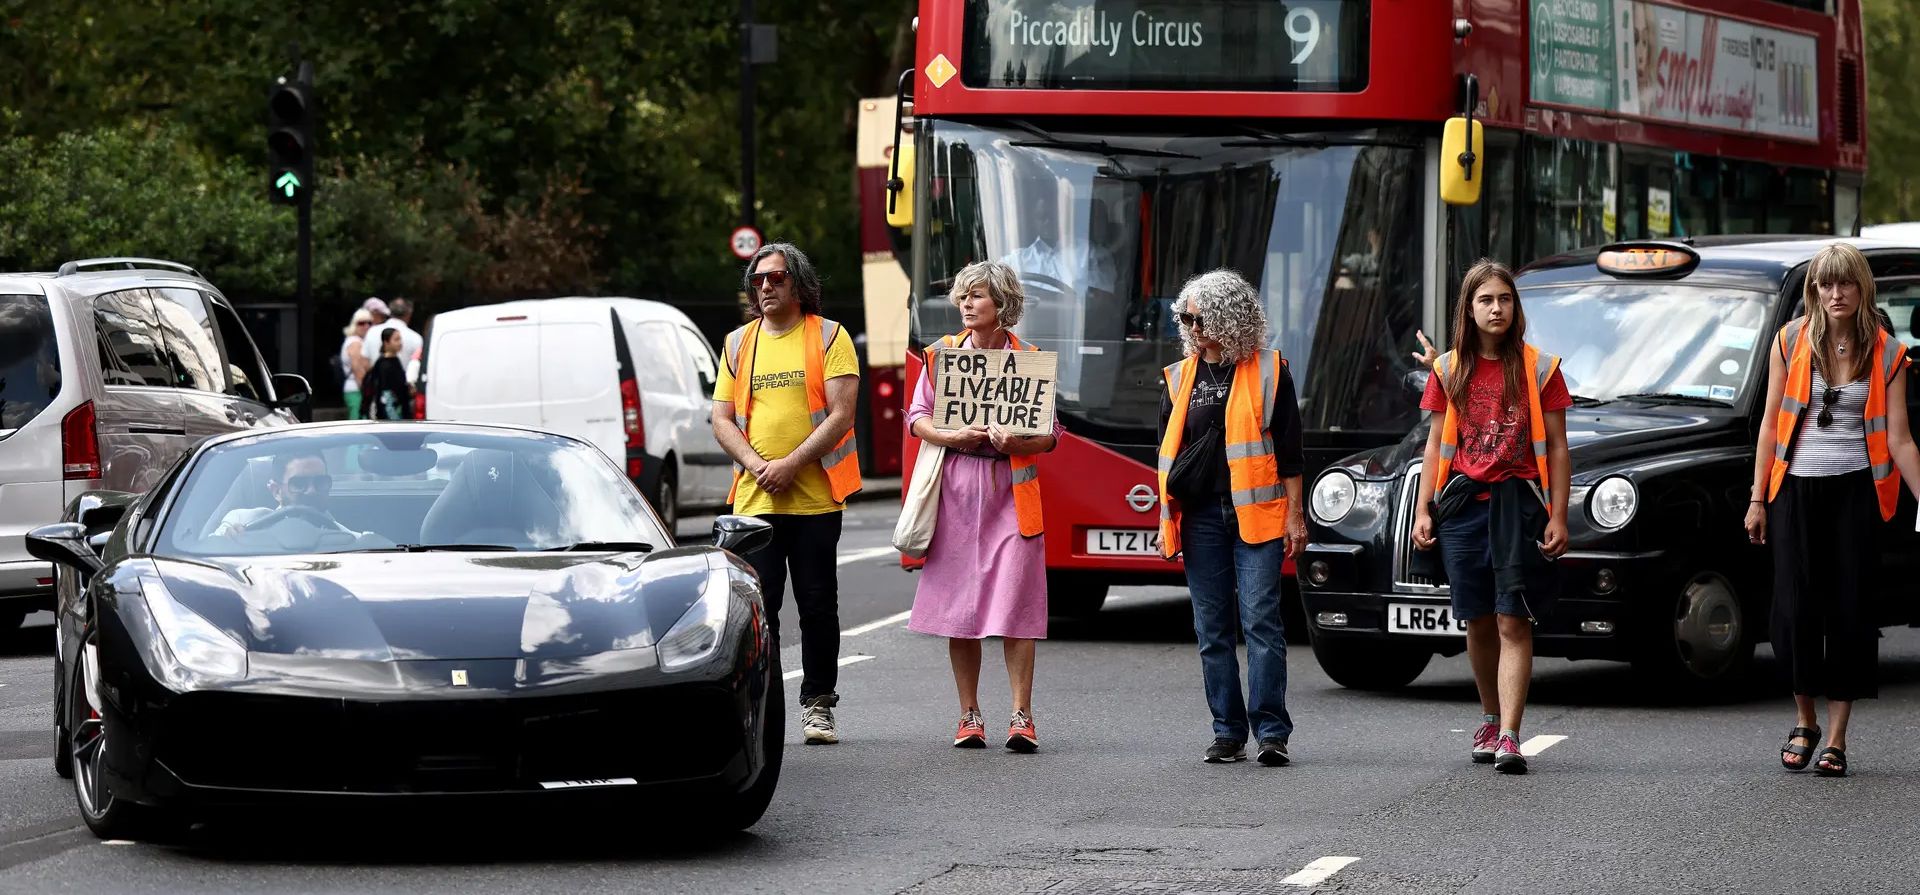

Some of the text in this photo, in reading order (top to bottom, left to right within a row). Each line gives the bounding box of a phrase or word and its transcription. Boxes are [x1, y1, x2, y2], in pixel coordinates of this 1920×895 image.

[1009, 9, 1202, 56] Piccadilly Circus
[1284, 7, 1320, 64] 9
[1655, 16, 1719, 117] small
[1614, 253, 1668, 266] TAXI
[944, 353, 1016, 376] FOR A
[753, 383, 764, 391] OF
[765, 379, 790, 389] FEAR
[943, 377, 1049, 405] LIVEABLE
[944, 400, 1041, 429] FUTURE
[1099, 532, 1137, 551] LTZ
[1396, 607, 1450, 631] LR64
